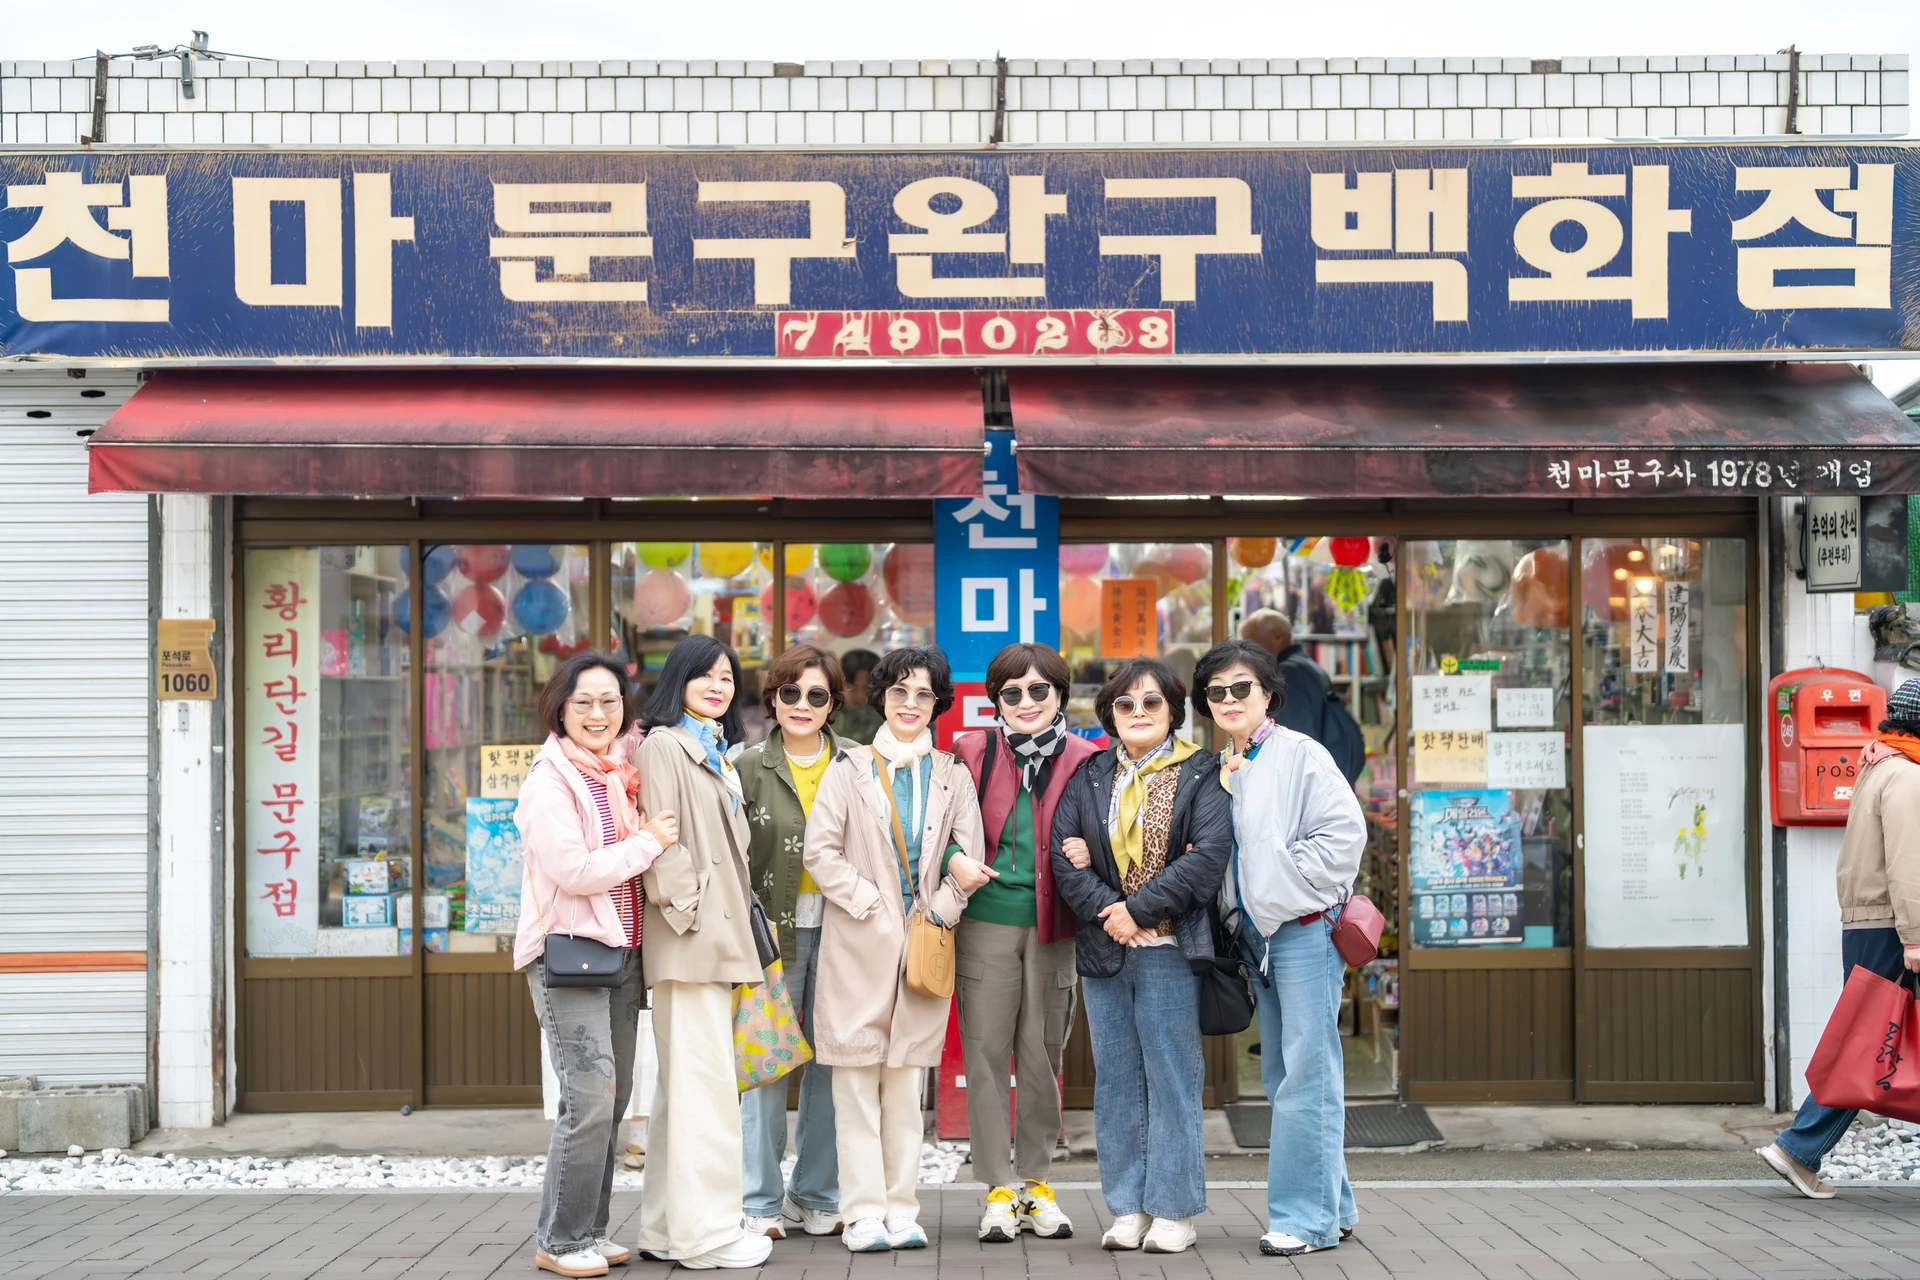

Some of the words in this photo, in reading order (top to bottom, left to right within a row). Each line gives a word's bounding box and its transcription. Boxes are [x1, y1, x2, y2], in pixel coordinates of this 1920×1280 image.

[1547, 459, 1697, 489] 천마문구사
[1811, 511, 1837, 542] 추억의
[1840, 508, 1857, 539] 간식
[1818, 544, 1851, 567] (주전부리)
[162, 650, 191, 661] 포석로
[161, 673, 210, 692] 1060
[262, 580, 308, 763] 황리단길
[1821, 689, 1862, 702] 우편
[1817, 766, 1855, 777] POS
[258, 782, 304, 917] 문구점
